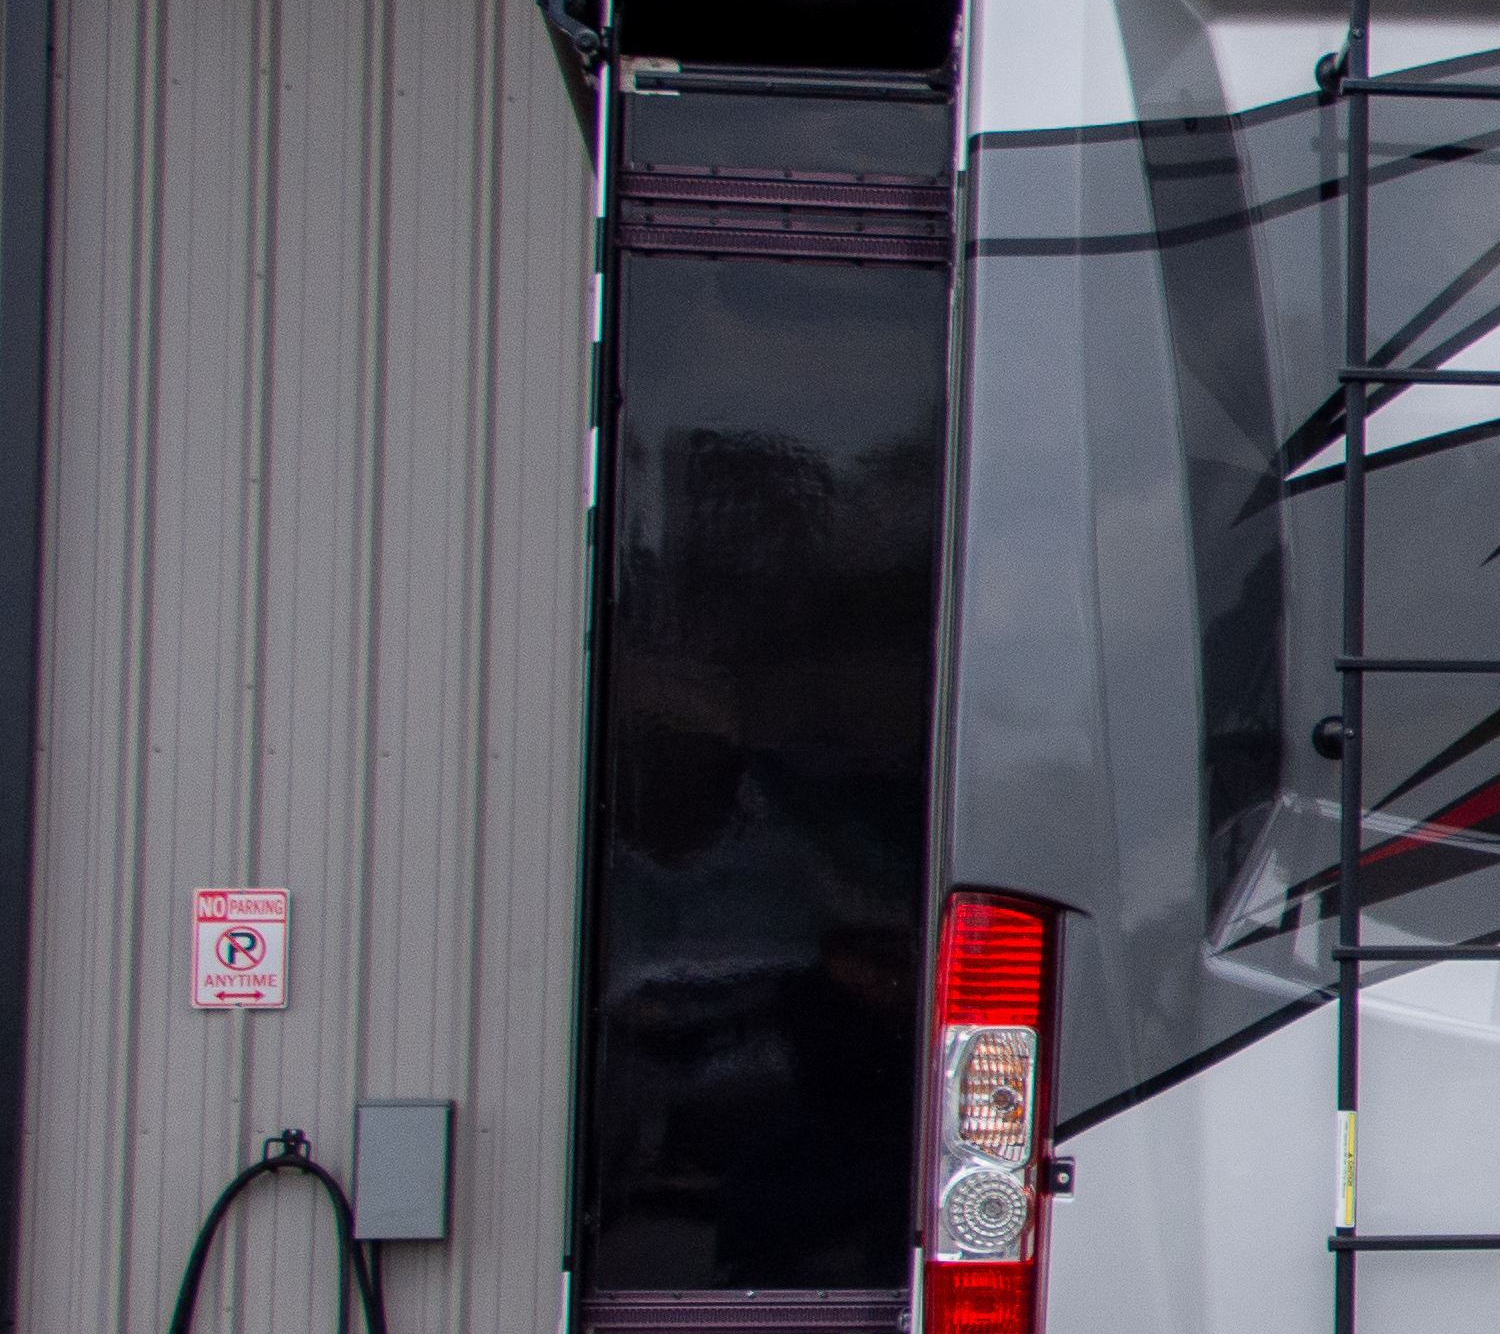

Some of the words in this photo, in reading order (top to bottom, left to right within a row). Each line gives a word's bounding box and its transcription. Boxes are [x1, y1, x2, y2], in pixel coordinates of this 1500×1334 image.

[200, 895, 226, 918] NO
[230, 899, 283, 915] PARKING
[204, 974, 277, 988] ANYTIME
